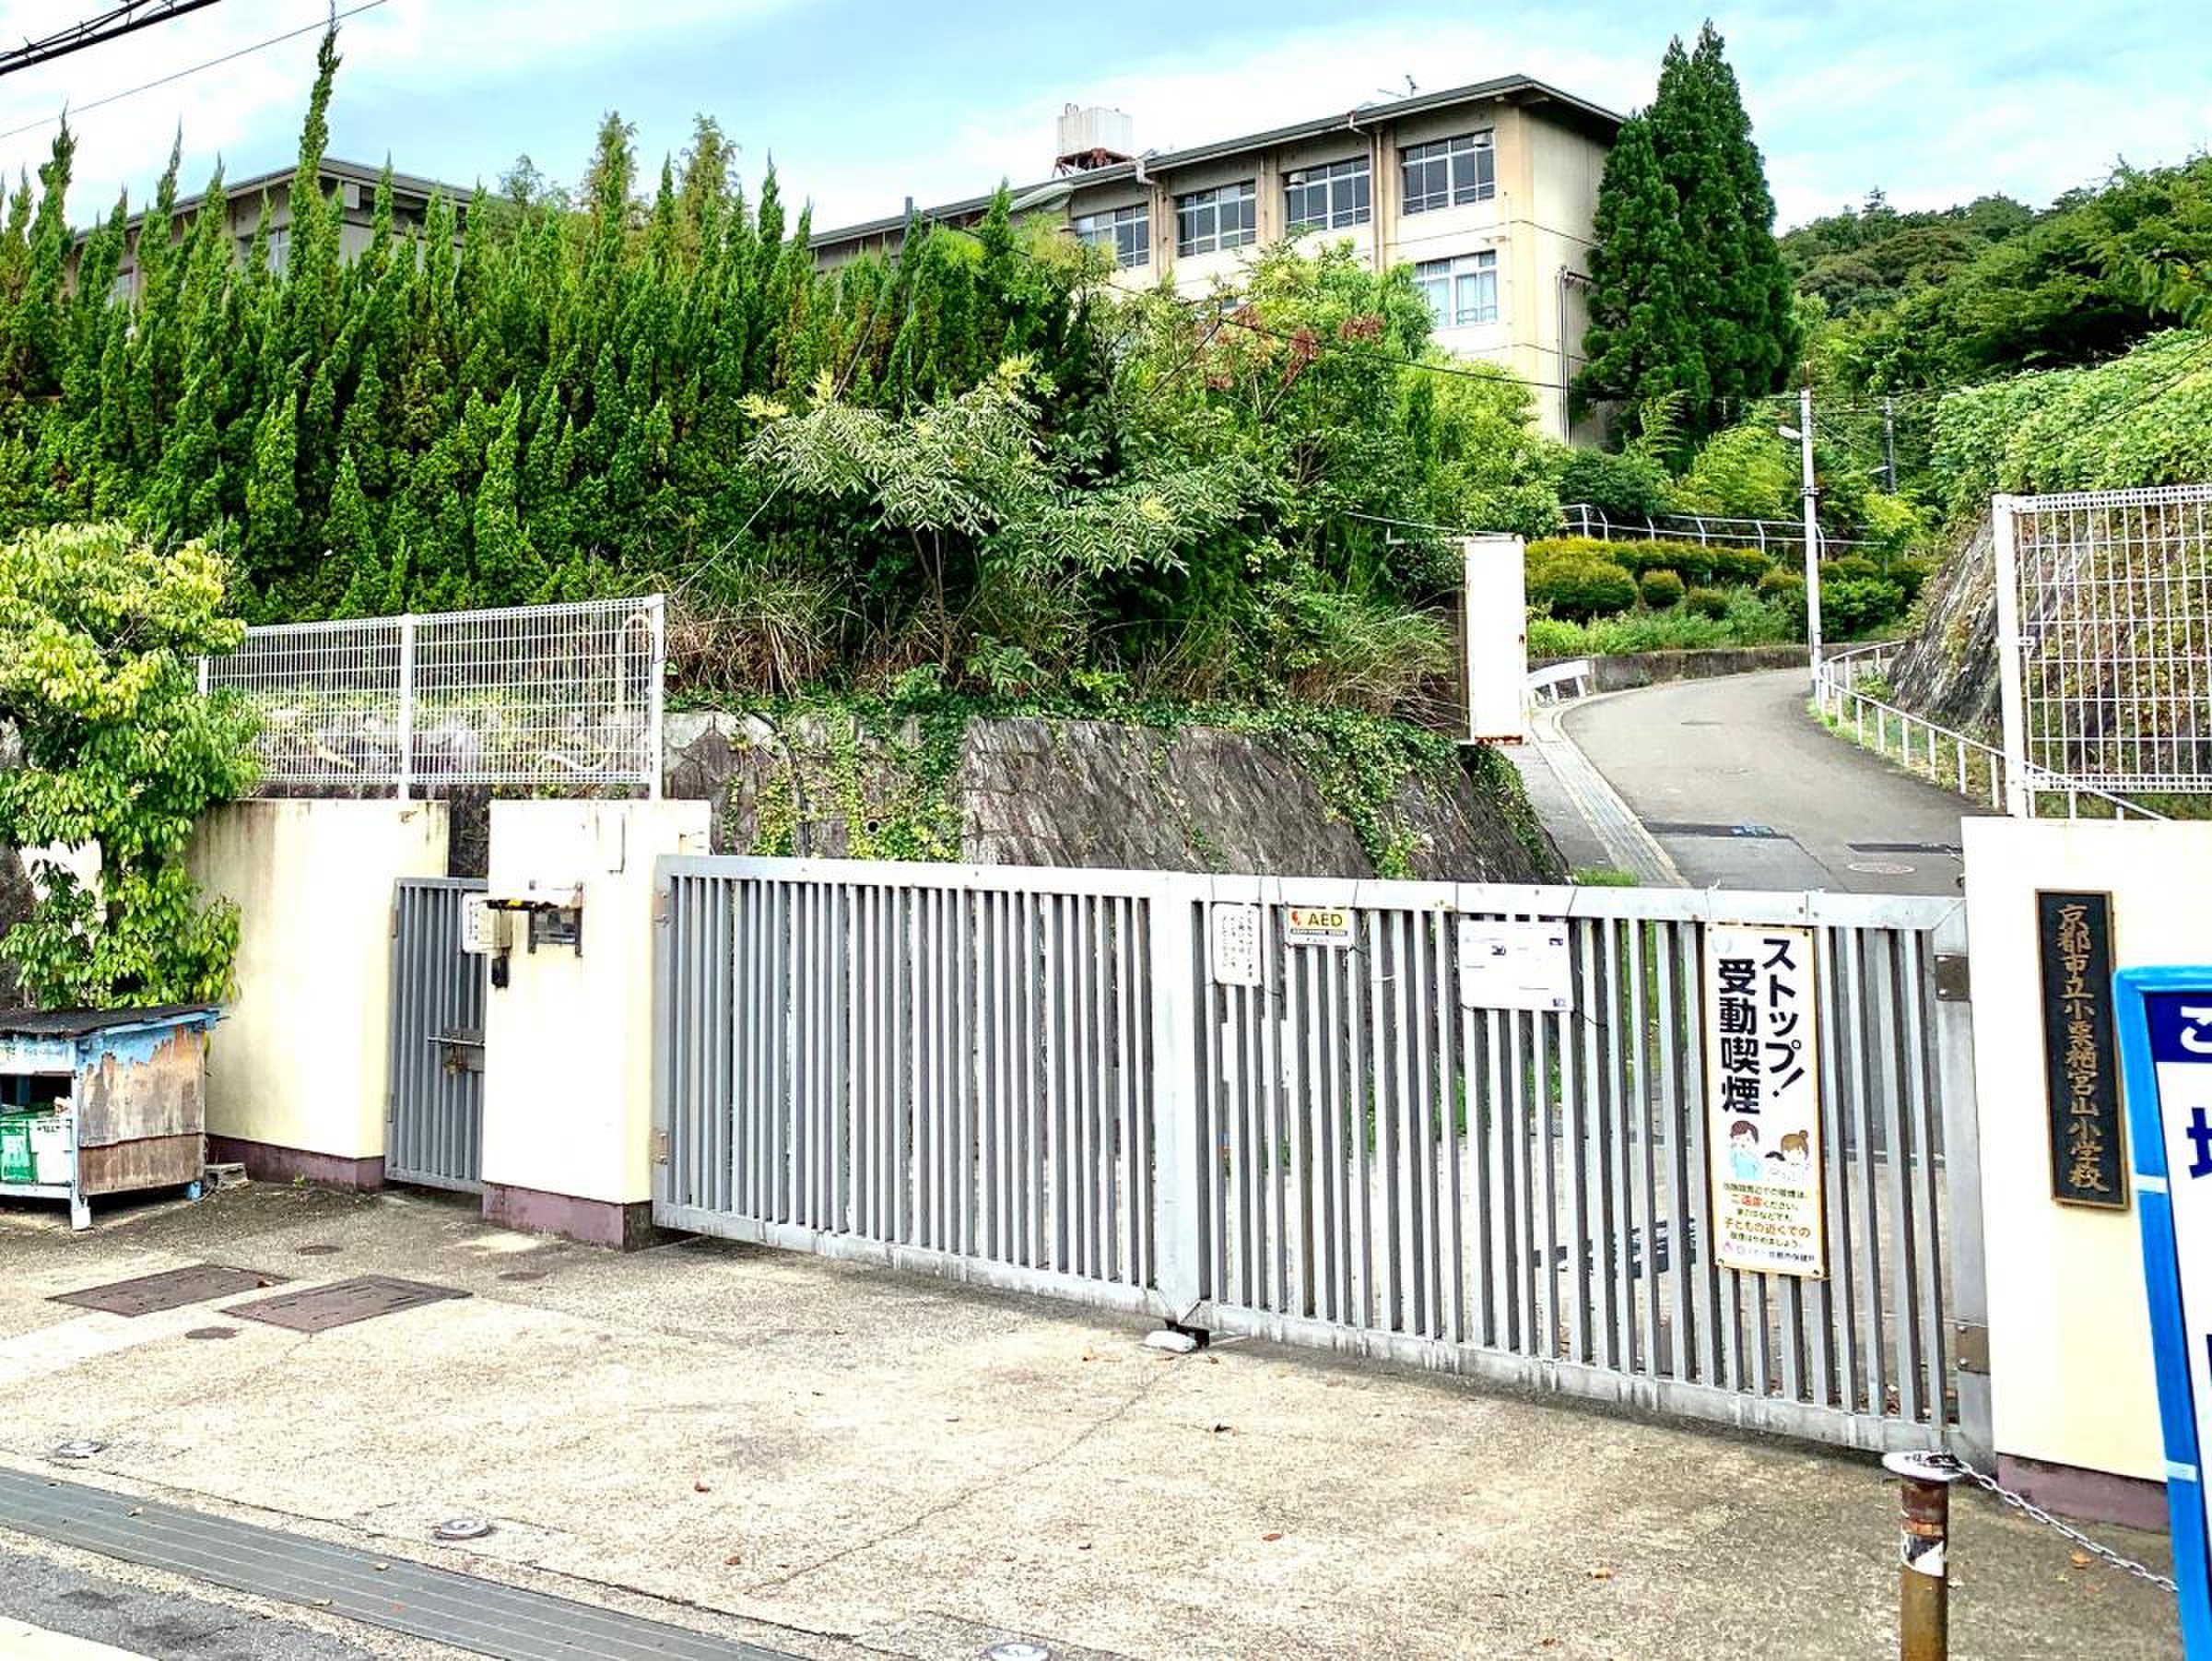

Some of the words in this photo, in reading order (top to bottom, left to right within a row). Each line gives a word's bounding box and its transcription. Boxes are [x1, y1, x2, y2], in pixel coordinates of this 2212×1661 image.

[1308, 913, 1343, 927] AED
[1718, 958, 1760, 1115] 受動喫煙
[1761, 937, 1806, 1098] ストップ！
[2055, 902, 2110, 1193] 京都市立小栗栖宮山小学校
